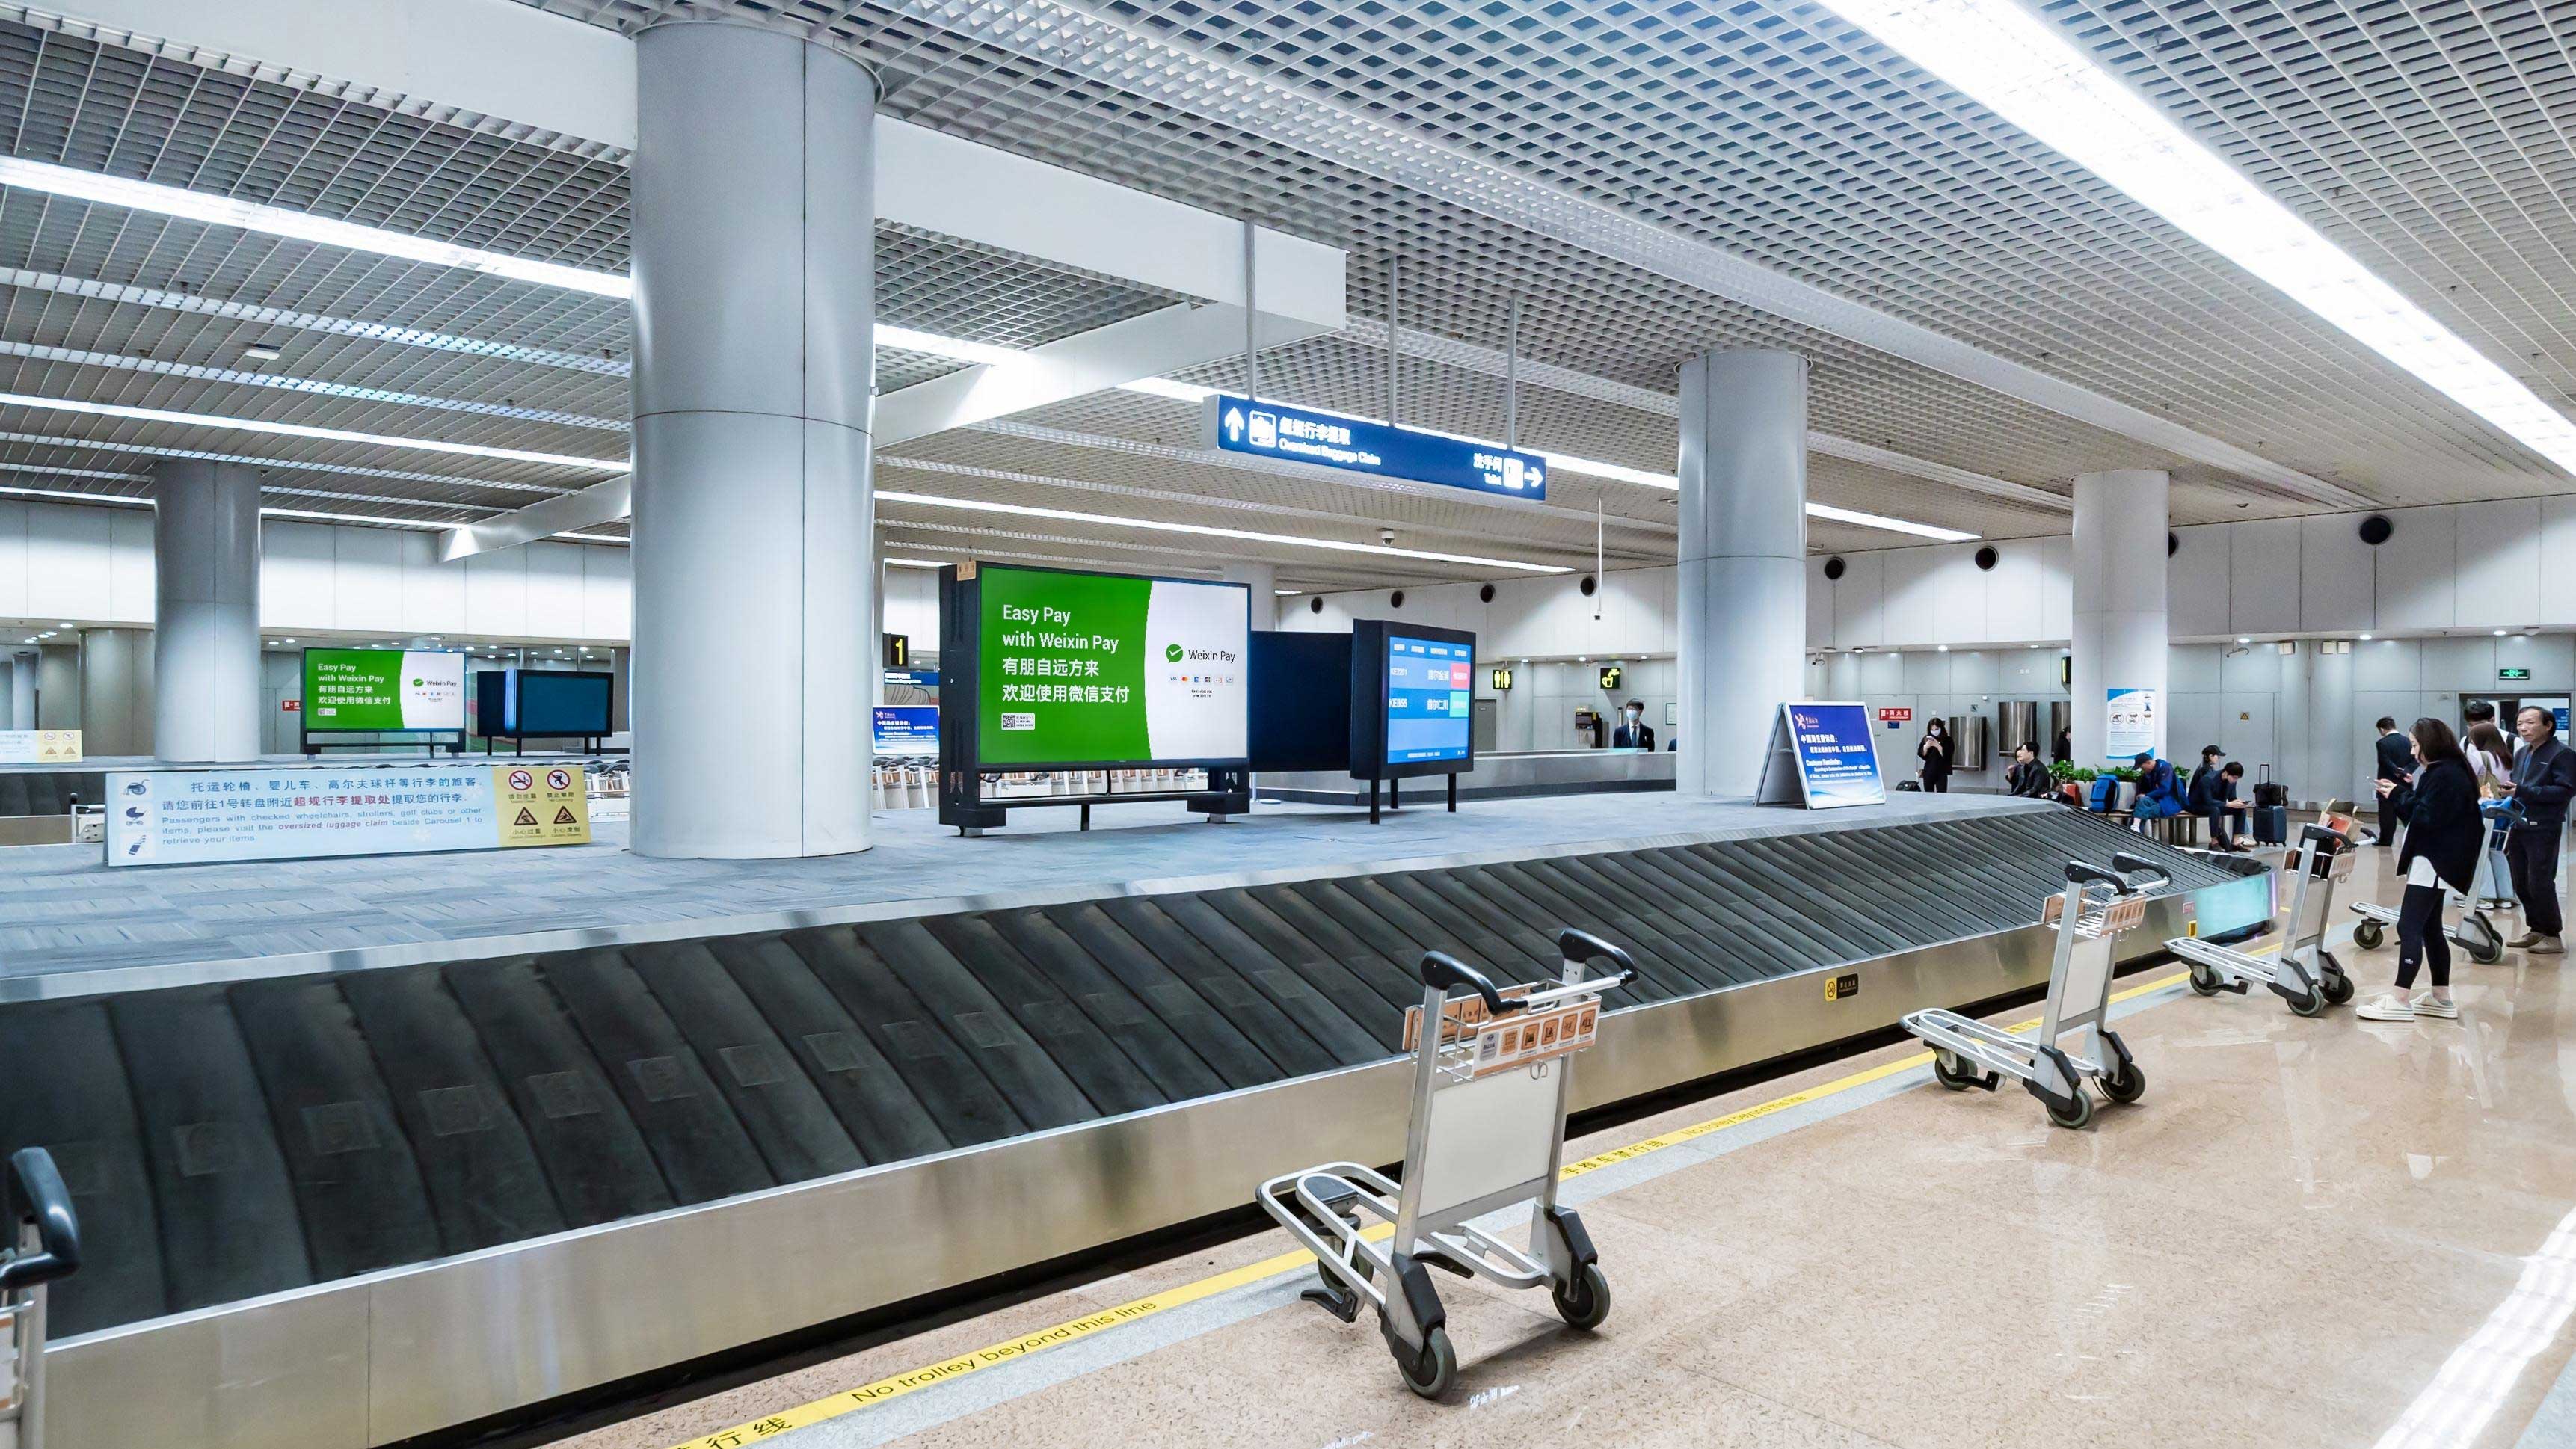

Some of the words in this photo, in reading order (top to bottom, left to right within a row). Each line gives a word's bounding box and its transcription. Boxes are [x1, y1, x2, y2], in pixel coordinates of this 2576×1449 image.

[1321, 444, 1358, 464] Baggage
[1003, 604, 1039, 625] Easy
[1043, 607, 1071, 627] Pay
[895, 639, 903, 665] 1
[1002, 631, 1035, 647] with
[1039, 633, 1088, 649] Weixin
[1092, 635, 1119, 654] Pay
[1188, 650, 1218, 660] Weixin
[1220, 651, 1235, 663] Pay
[318, 664, 338, 672] Easy
[340, 664, 356, 672] Pay
[1002, 657, 1100, 677] 有朋自远方来
[369, 675, 384, 683] Pay
[318, 696, 390, 704] 欢迎使用微信支付
[1002, 684, 1130, 703] 欢迎使用微信支付
[162, 816, 221, 825] Passengers
[295, 810, 352, 819] wheelchairs,
[400, 810, 416, 818] golf
[197, 825, 230, 834] please
[278, 822, 322, 831] oversized
[326, 820, 361, 830] luggage
[425, 817, 462, 825] Carousel
[162, 837, 200, 846] retrieve
[204, 836, 225, 845] your
[852, 1385, 894, 1403] No
[898, 1359, 976, 1388] trolley
[979, 1328, 1072, 1361] beyond
[1072, 1314, 1115, 1332] this
[1115, 1302, 1157, 1317] line
[677, 1418, 793, 1449] 行线
